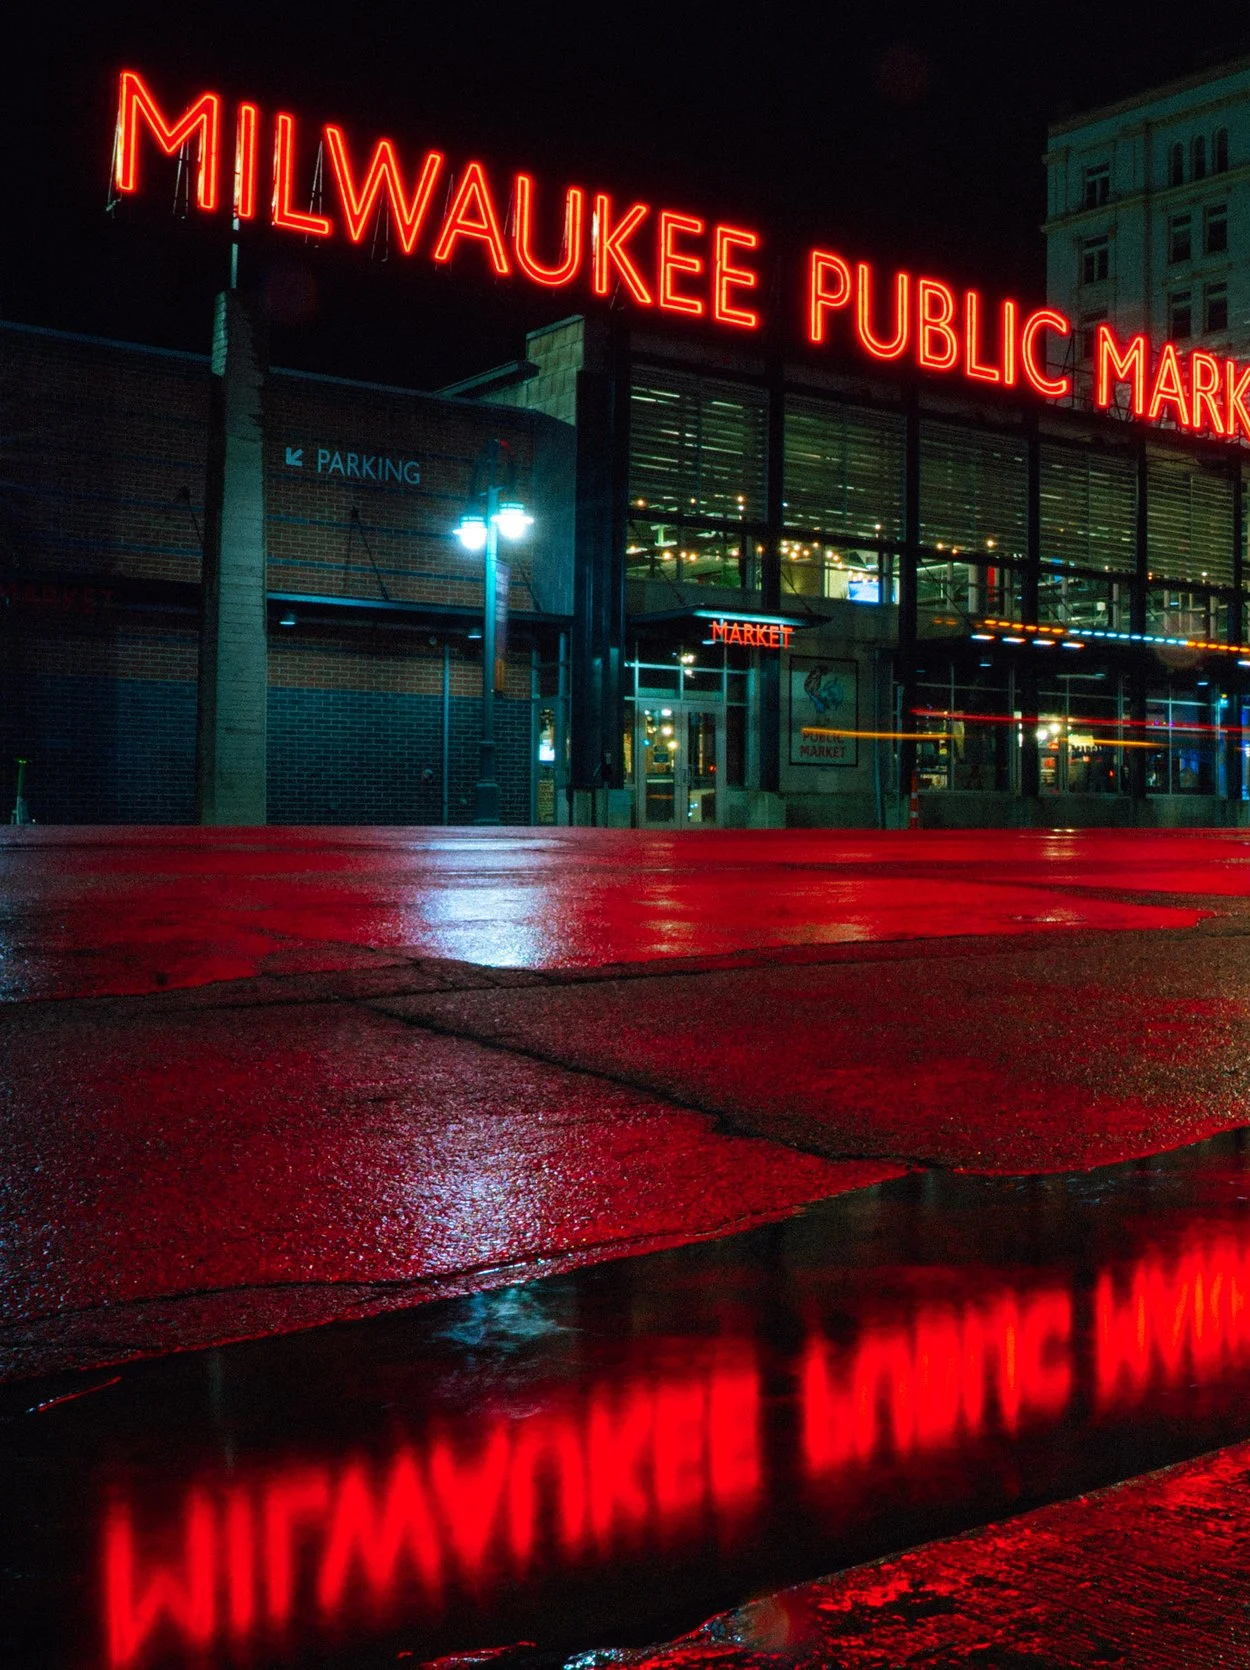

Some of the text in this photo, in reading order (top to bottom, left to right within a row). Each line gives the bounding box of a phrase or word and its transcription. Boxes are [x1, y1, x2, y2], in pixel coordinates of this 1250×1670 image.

[114, 69, 762, 330] MILWAUKEE
[806, 248, 1072, 398] PUBLIC
[317, 448, 421, 485] PARKING
[711, 620, 794, 650] MARKET
[799, 745, 846, 759] MARKET
